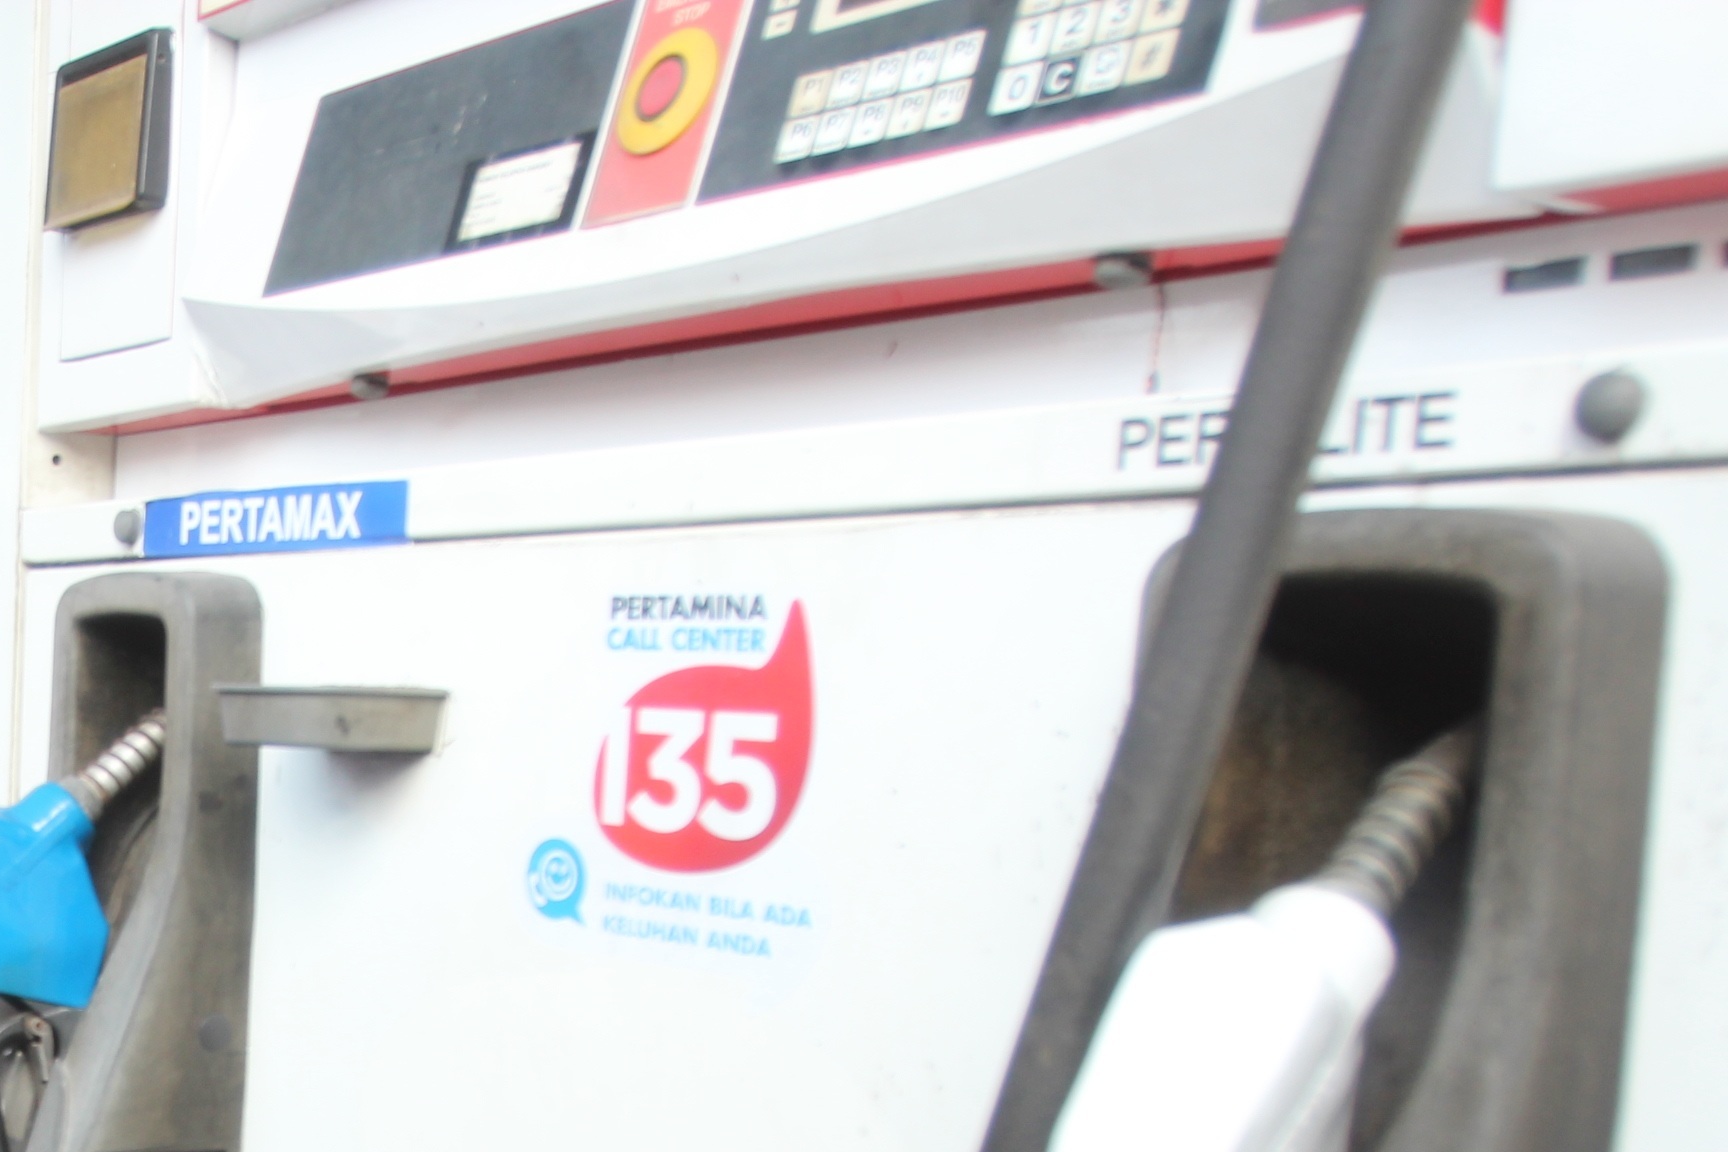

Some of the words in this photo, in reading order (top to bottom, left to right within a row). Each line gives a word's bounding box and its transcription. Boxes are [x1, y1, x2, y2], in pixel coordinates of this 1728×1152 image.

[1065, 7, 1089, 34] 2
[1042, 63, 1075, 95] C
[1116, 390, 1458, 471] PERITE
[179, 490, 364, 546] PERTAMAX
[610, 594, 768, 621] PERTAMINA
[606, 626, 662, 652] CALL
[671, 627, 766, 653] CENTER
[600, 704, 780, 842] 135
[605, 881, 701, 914] INFOKAN
[708, 895, 755, 922] BILA
[763, 901, 813, 929] ADA
[601, 915, 699, 947] KELUHAN
[706, 929, 772, 958] ANDA
